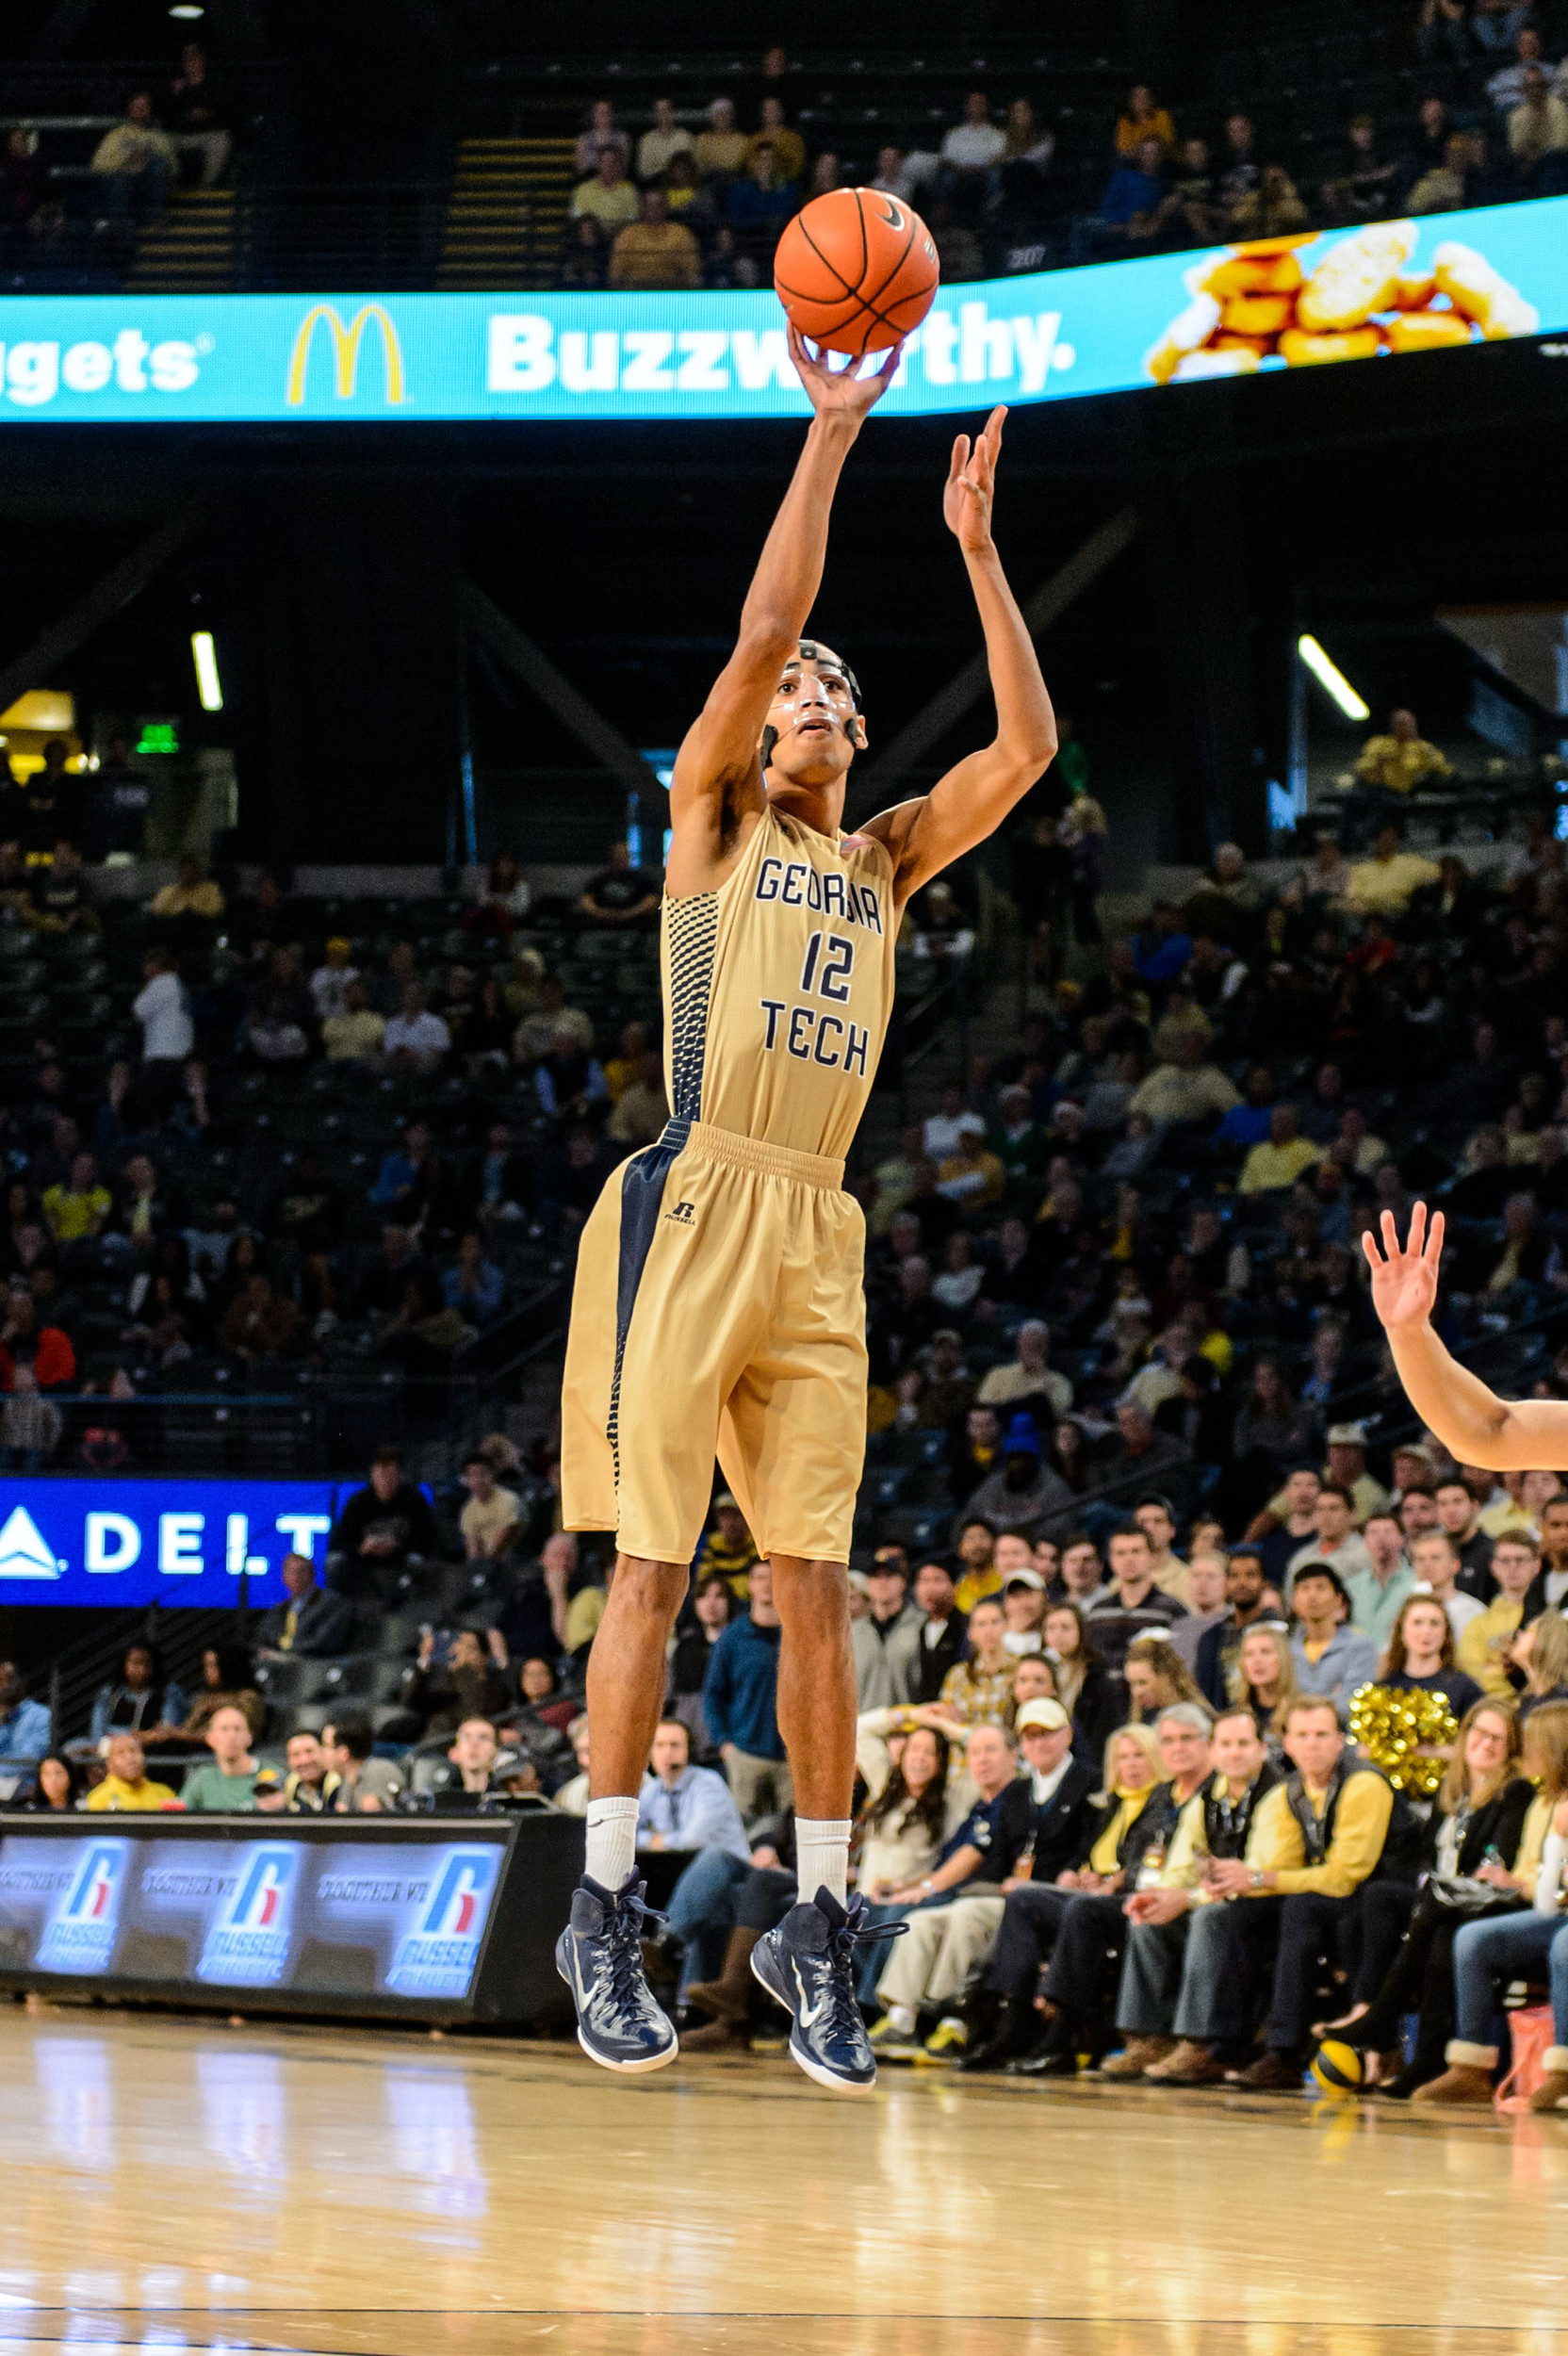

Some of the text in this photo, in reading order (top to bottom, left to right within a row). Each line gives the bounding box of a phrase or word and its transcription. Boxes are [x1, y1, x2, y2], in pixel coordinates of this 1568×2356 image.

[0, 328, 200, 407] gets
[488, 301, 1076, 393] Buzzwthy.
[799, 929, 856, 1006] 12
[759, 998, 870, 1082] TECH
